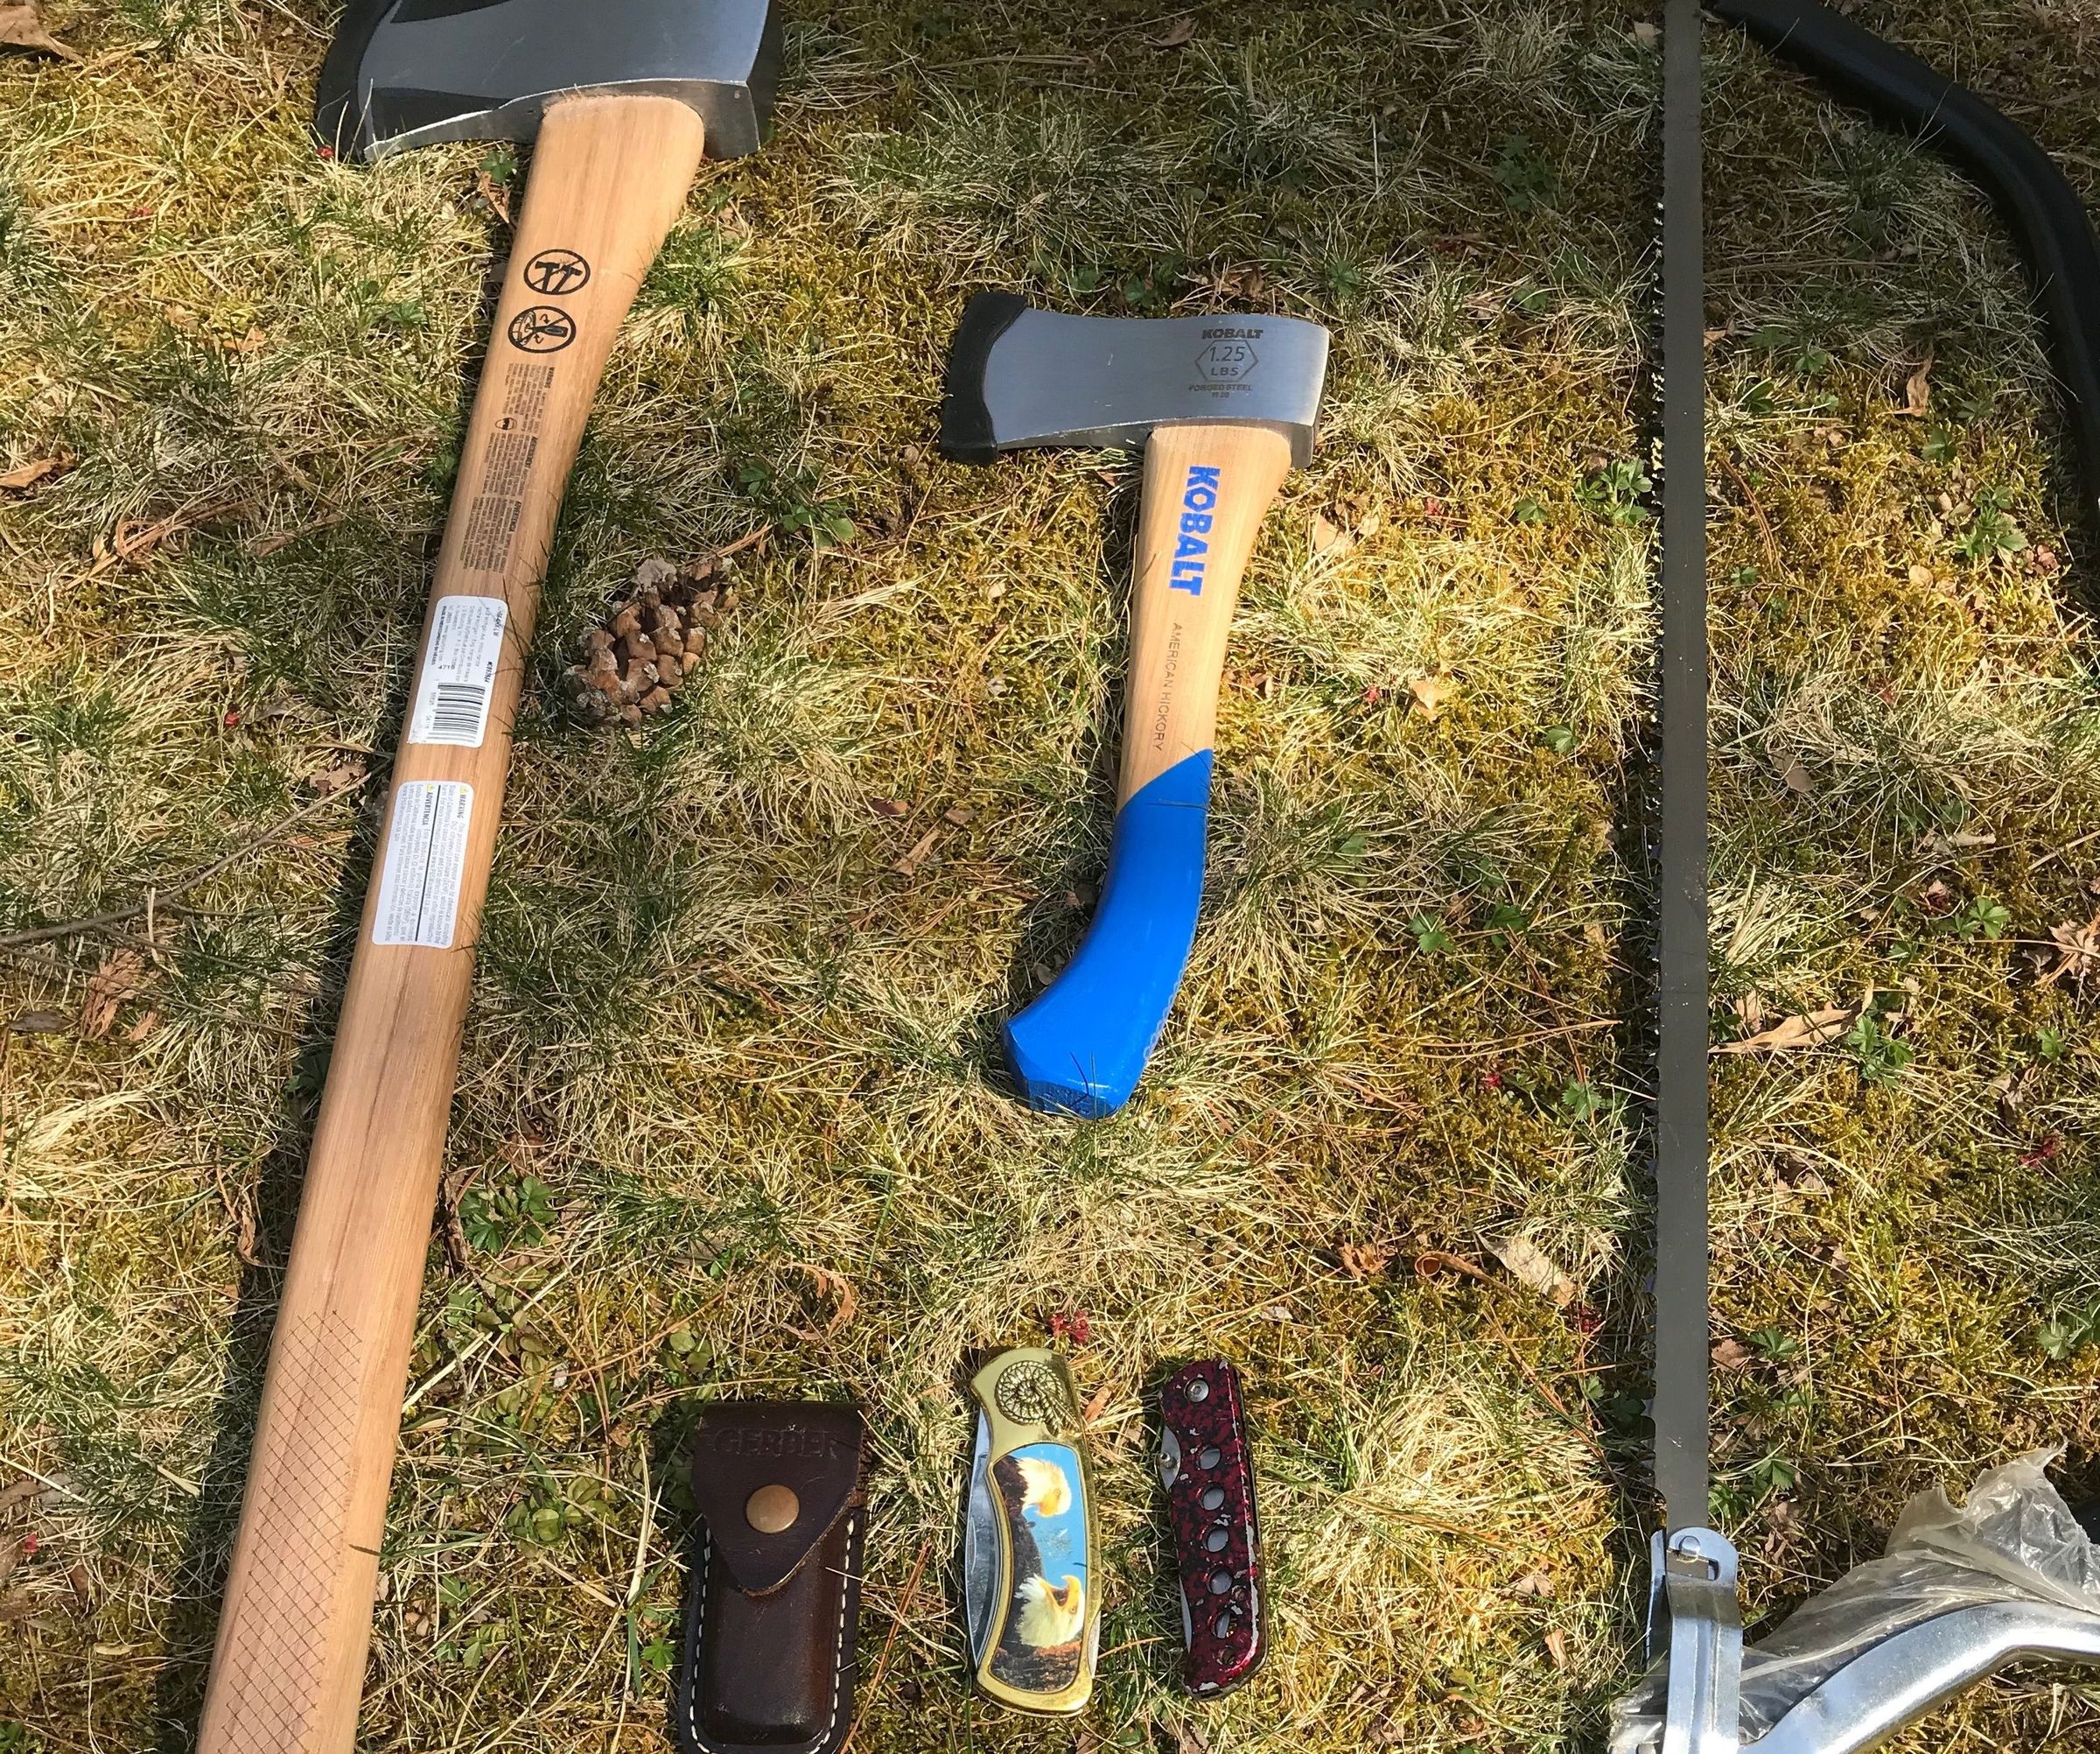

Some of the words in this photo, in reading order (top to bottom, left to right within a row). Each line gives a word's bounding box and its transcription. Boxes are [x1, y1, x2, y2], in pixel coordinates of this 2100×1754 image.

[1202, 328, 1263, 340] KOBALT
[1209, 346, 1245, 361] 1.25
[1211, 367, 1239, 375] LBS
[1169, 466, 1221, 596] KOBALT
[1163, 623, 1182, 688] AMERICAN
[1152, 692, 1172, 751] HICKORY
[421, 791, 433, 825] ADVERTENCIA
